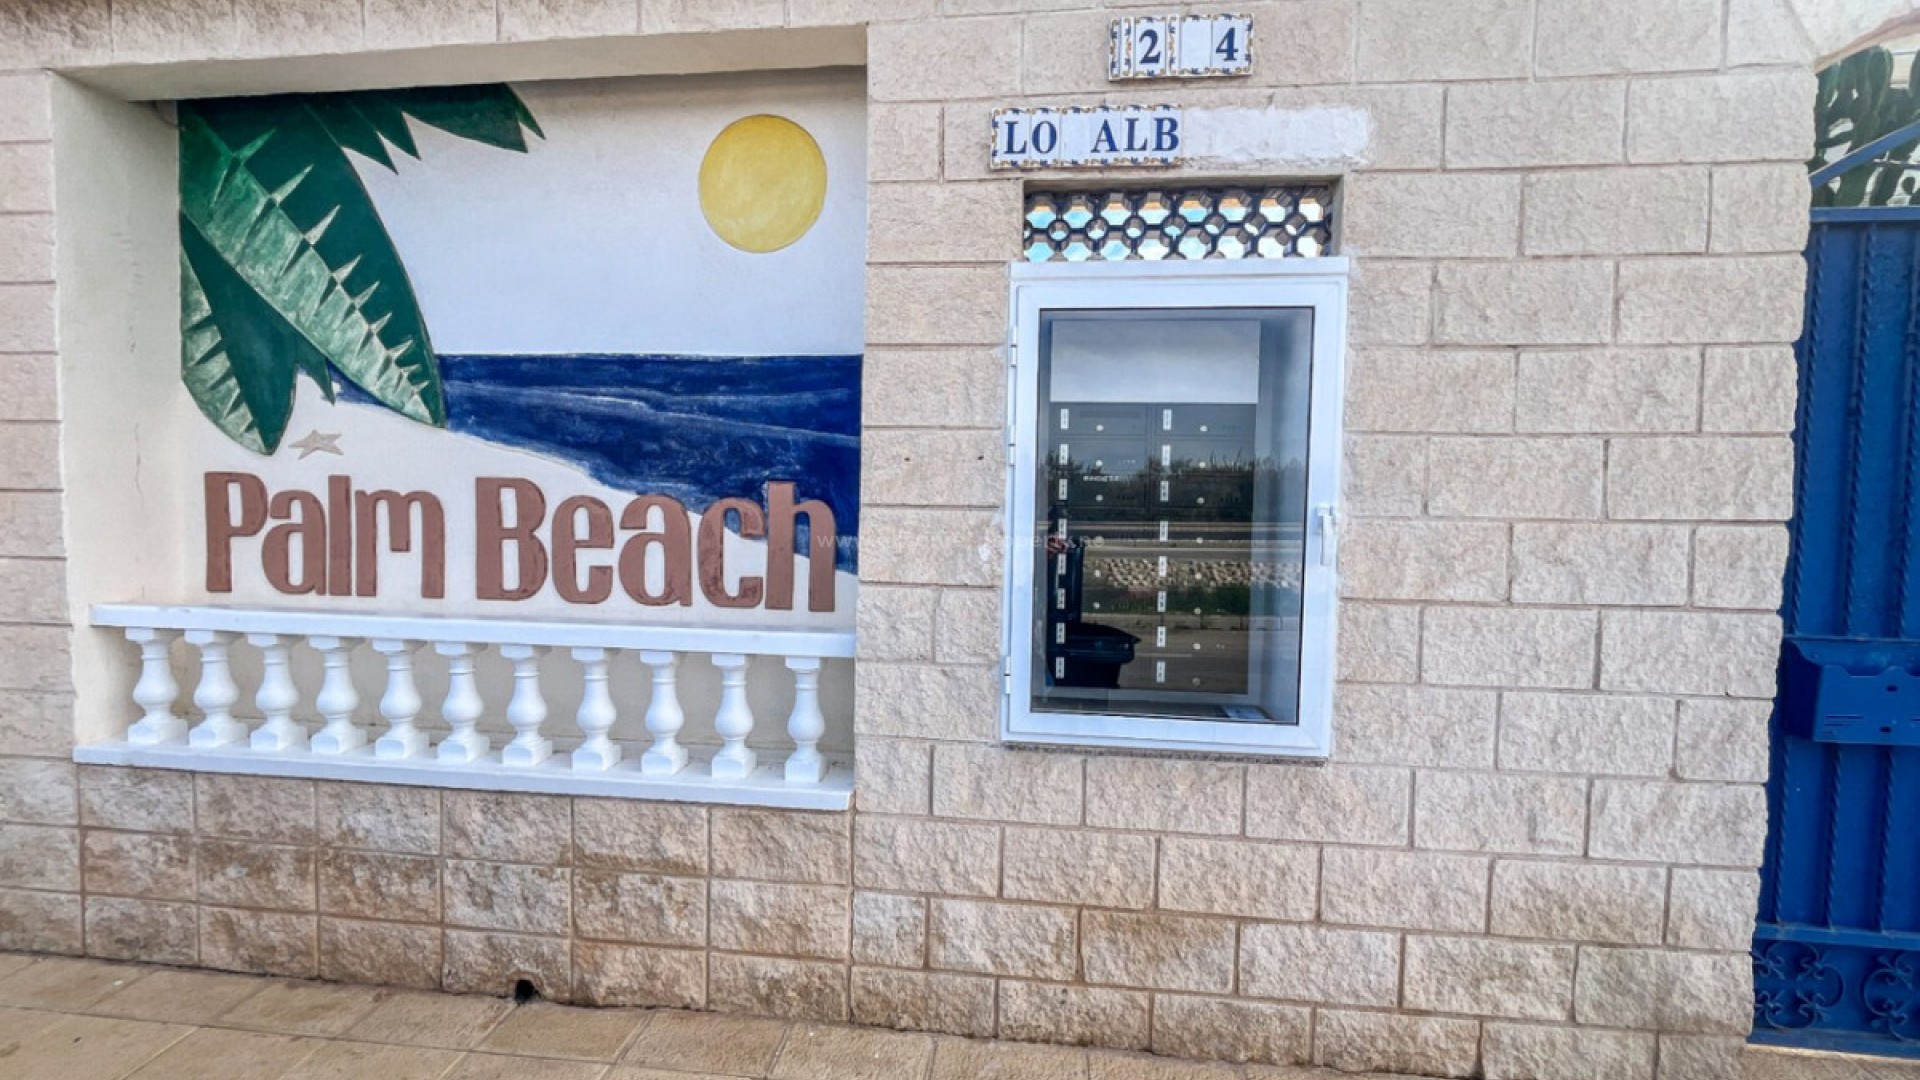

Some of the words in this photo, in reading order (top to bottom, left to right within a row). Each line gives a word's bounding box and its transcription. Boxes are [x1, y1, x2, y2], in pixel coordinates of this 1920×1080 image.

[1138, 28, 1161, 64] 2
[1215, 27, 1239, 62] 4
[1004, 120, 1058, 154] LO
[1090, 117, 1180, 154] ALB
[204, 471, 445, 599] Palm
[475, 476, 837, 613] Beach
